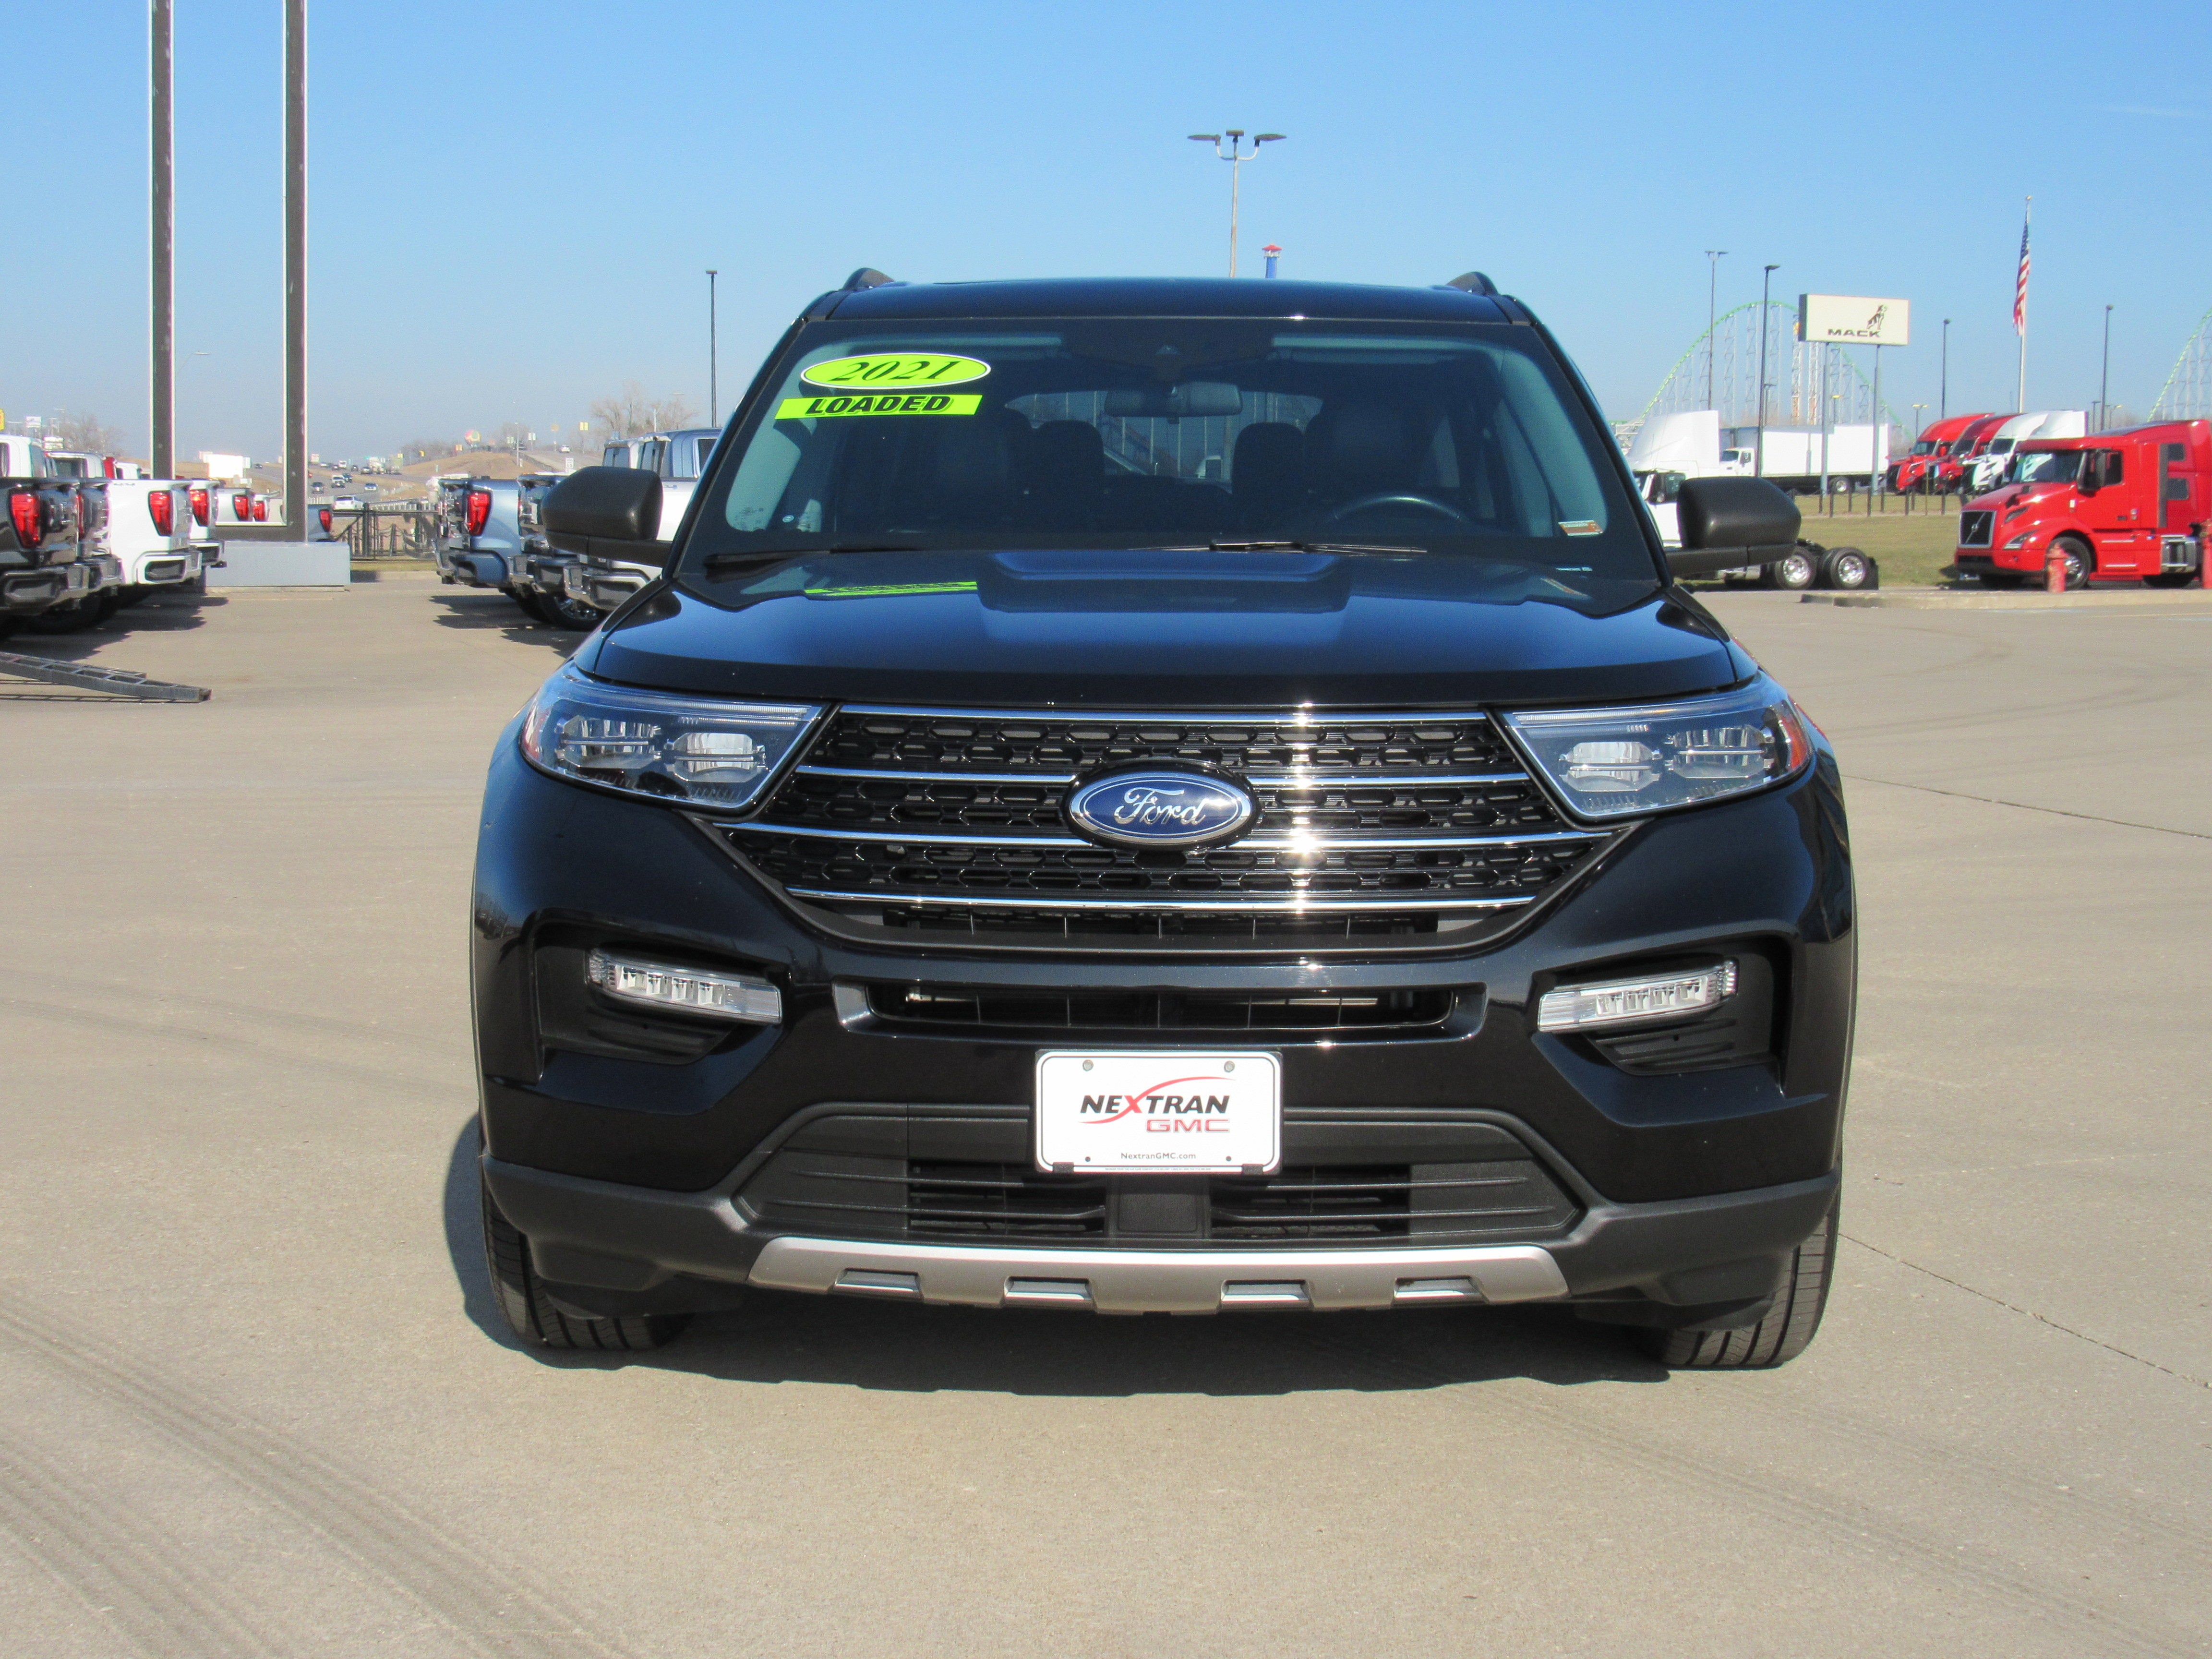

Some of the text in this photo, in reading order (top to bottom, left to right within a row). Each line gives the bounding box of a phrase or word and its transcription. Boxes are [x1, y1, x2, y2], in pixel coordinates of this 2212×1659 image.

[1827, 329, 1881, 337] MACK
[827, 361, 961, 381] 2021
[805, 396, 954, 416] LOADED
[1114, 787, 1206, 825] Ford
[1080, 1095, 1230, 1114] NEXTRAN
[1146, 1119, 1230, 1133] GMC
